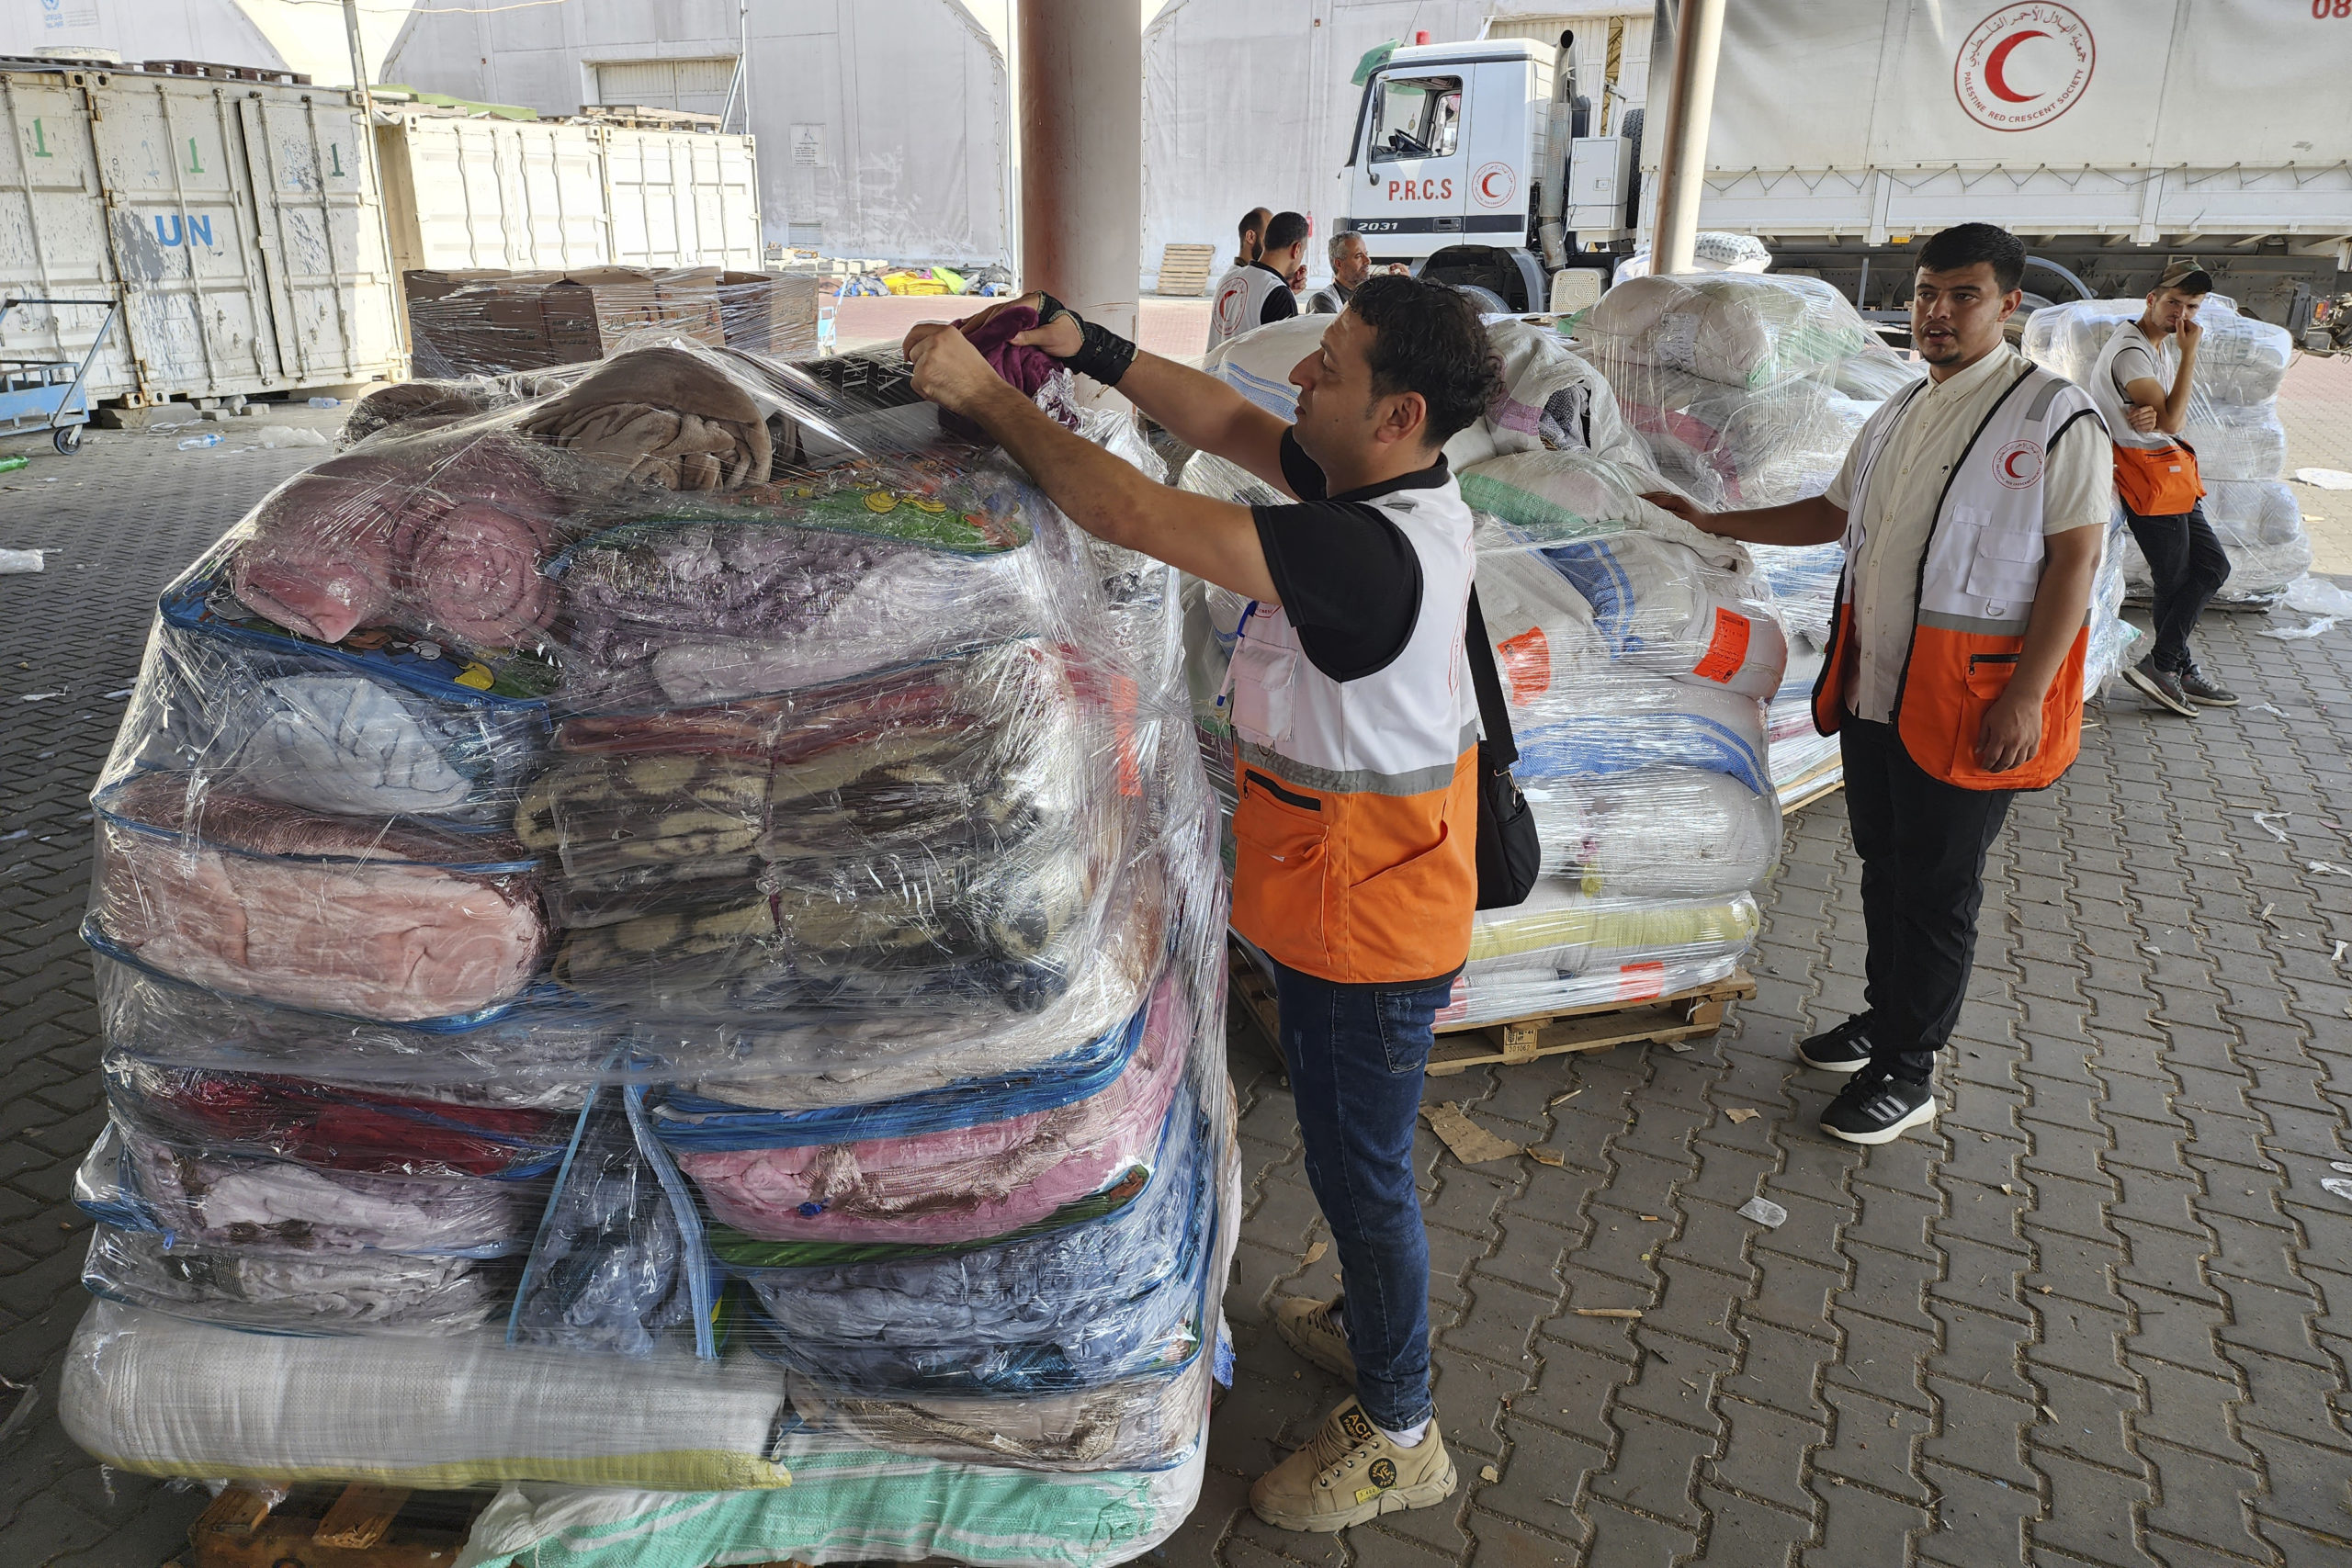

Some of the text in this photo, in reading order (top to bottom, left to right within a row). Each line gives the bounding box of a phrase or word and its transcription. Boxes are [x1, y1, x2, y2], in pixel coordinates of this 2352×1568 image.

[2043, 11, 2077, 34] الهلال
[2069, 33, 2086, 62] جمعية
[1963, 69, 2084, 123] PALESTINE RED CRESCENT SOCIETY
[32, 118, 52, 157] 1
[188, 137, 205, 174] 1
[331, 142, 345, 177] 1
[1388, 178, 1453, 201] P.R.C.S
[154, 215, 213, 247] UN
[1357, 222, 1398, 231] 2031
